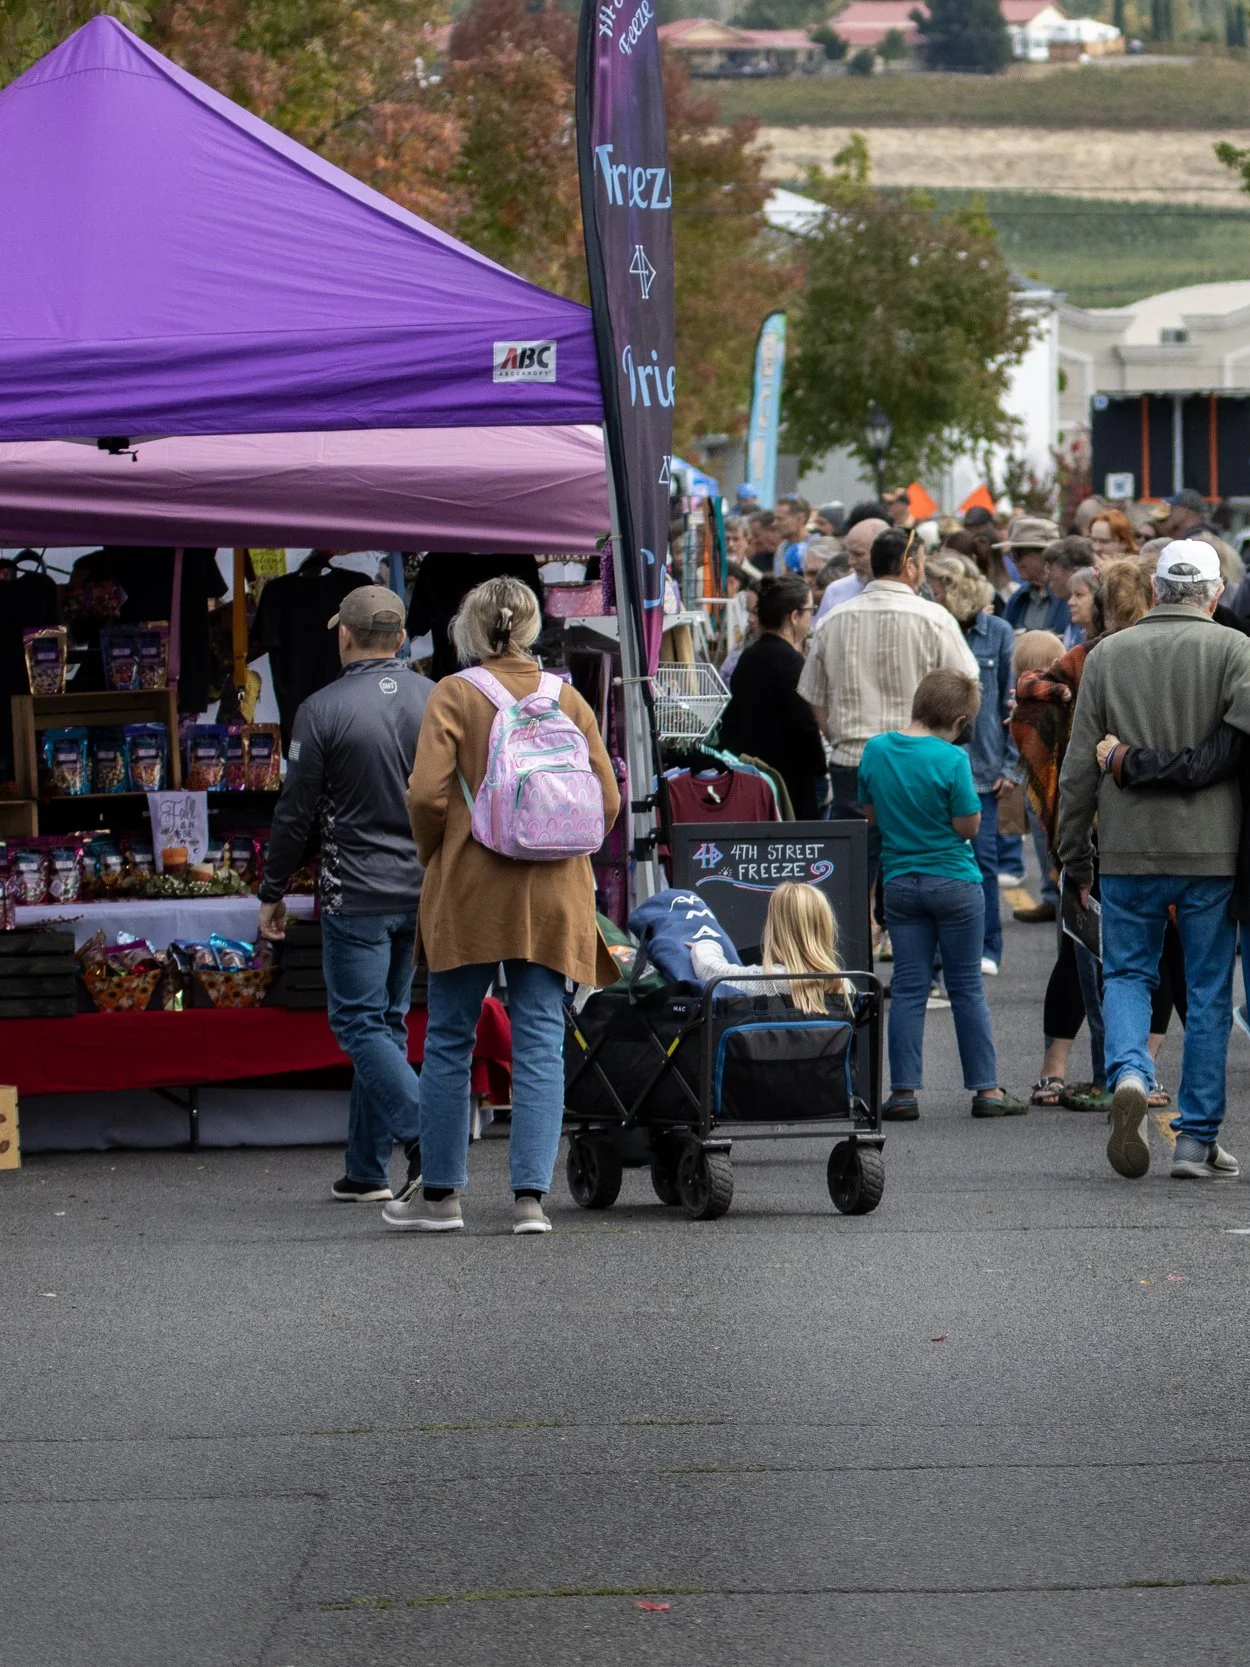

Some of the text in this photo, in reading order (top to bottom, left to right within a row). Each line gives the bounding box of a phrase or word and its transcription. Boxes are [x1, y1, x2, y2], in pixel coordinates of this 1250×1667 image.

[618, 0, 654, 55] Feeze
[501, 346, 551, 369] ABC
[160, 796, 196, 833] Fall
[730, 843, 824, 860] 4TH STREET
[738, 862, 806, 880] FREEZE
